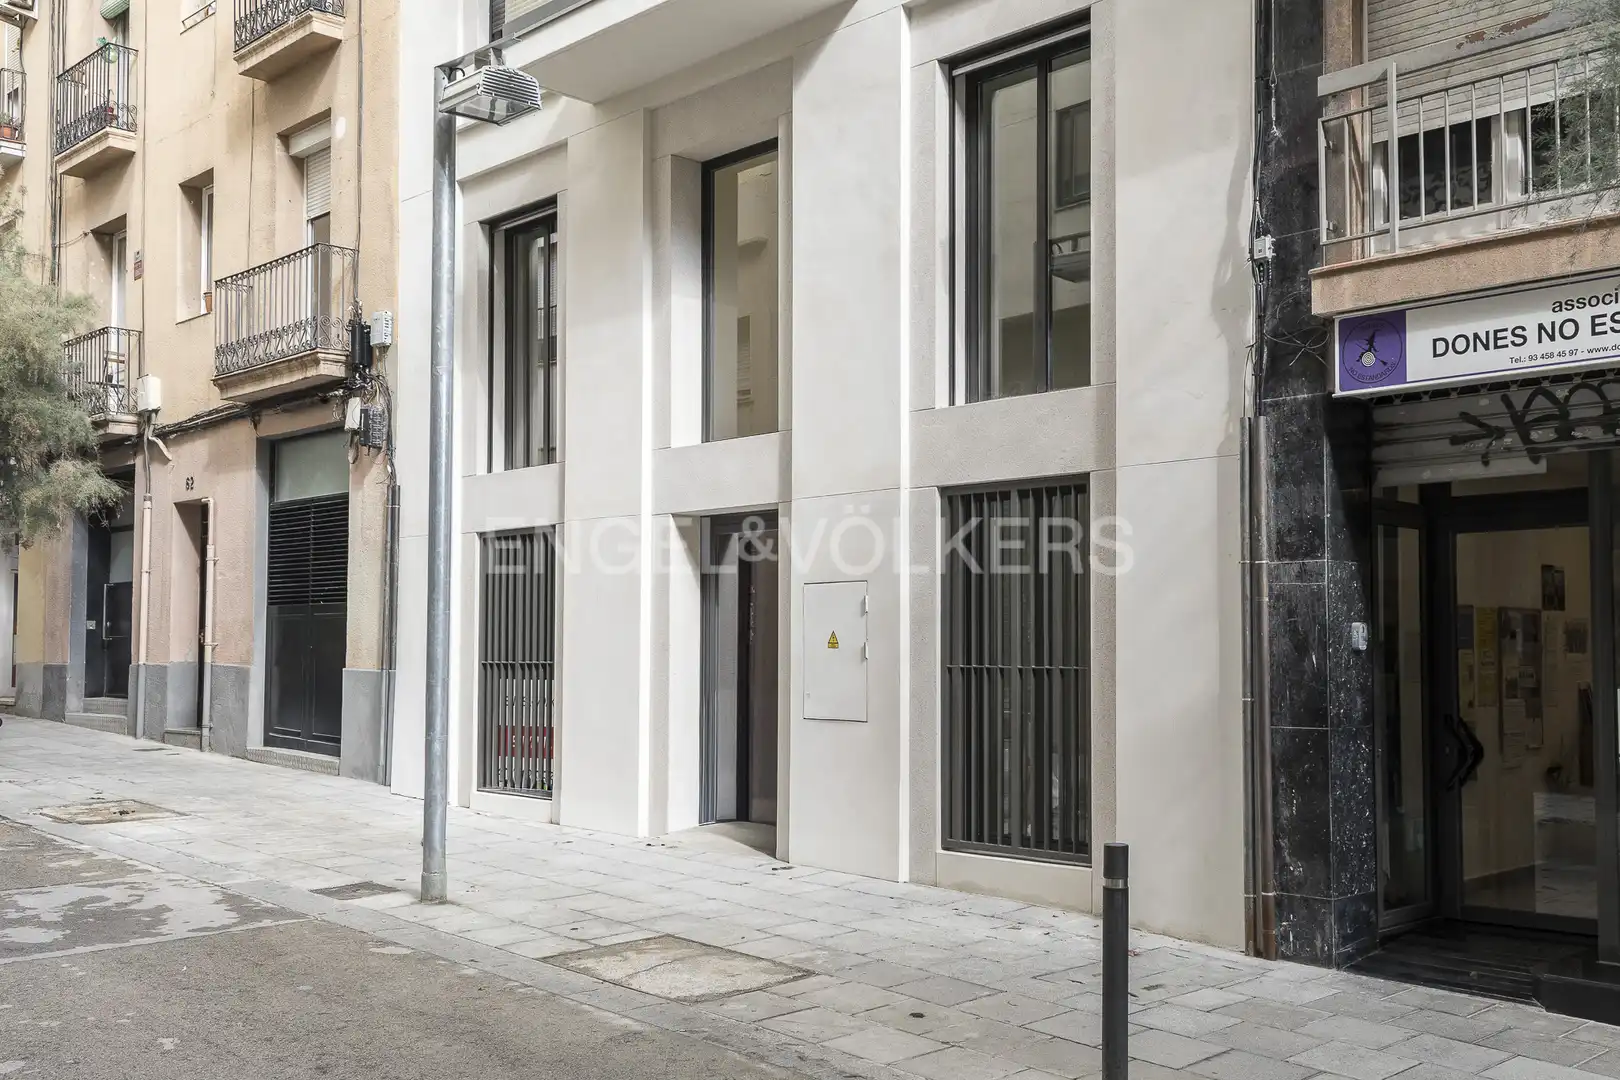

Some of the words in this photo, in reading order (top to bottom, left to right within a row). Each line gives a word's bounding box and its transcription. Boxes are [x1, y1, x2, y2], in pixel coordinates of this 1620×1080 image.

[1551, 287, 1619, 313] associ
[1432, 325, 1528, 358] DONES
[1537, 318, 1580, 344] NO
[1591, 311, 1620, 336] ES
[1509, 356, 1526, 364] Tel.:
[1528, 354, 1538, 362] 93
[1540, 352, 1555, 360] 458
[1556, 350, 1567, 358] 45
[1568, 348, 1579, 356] 97
